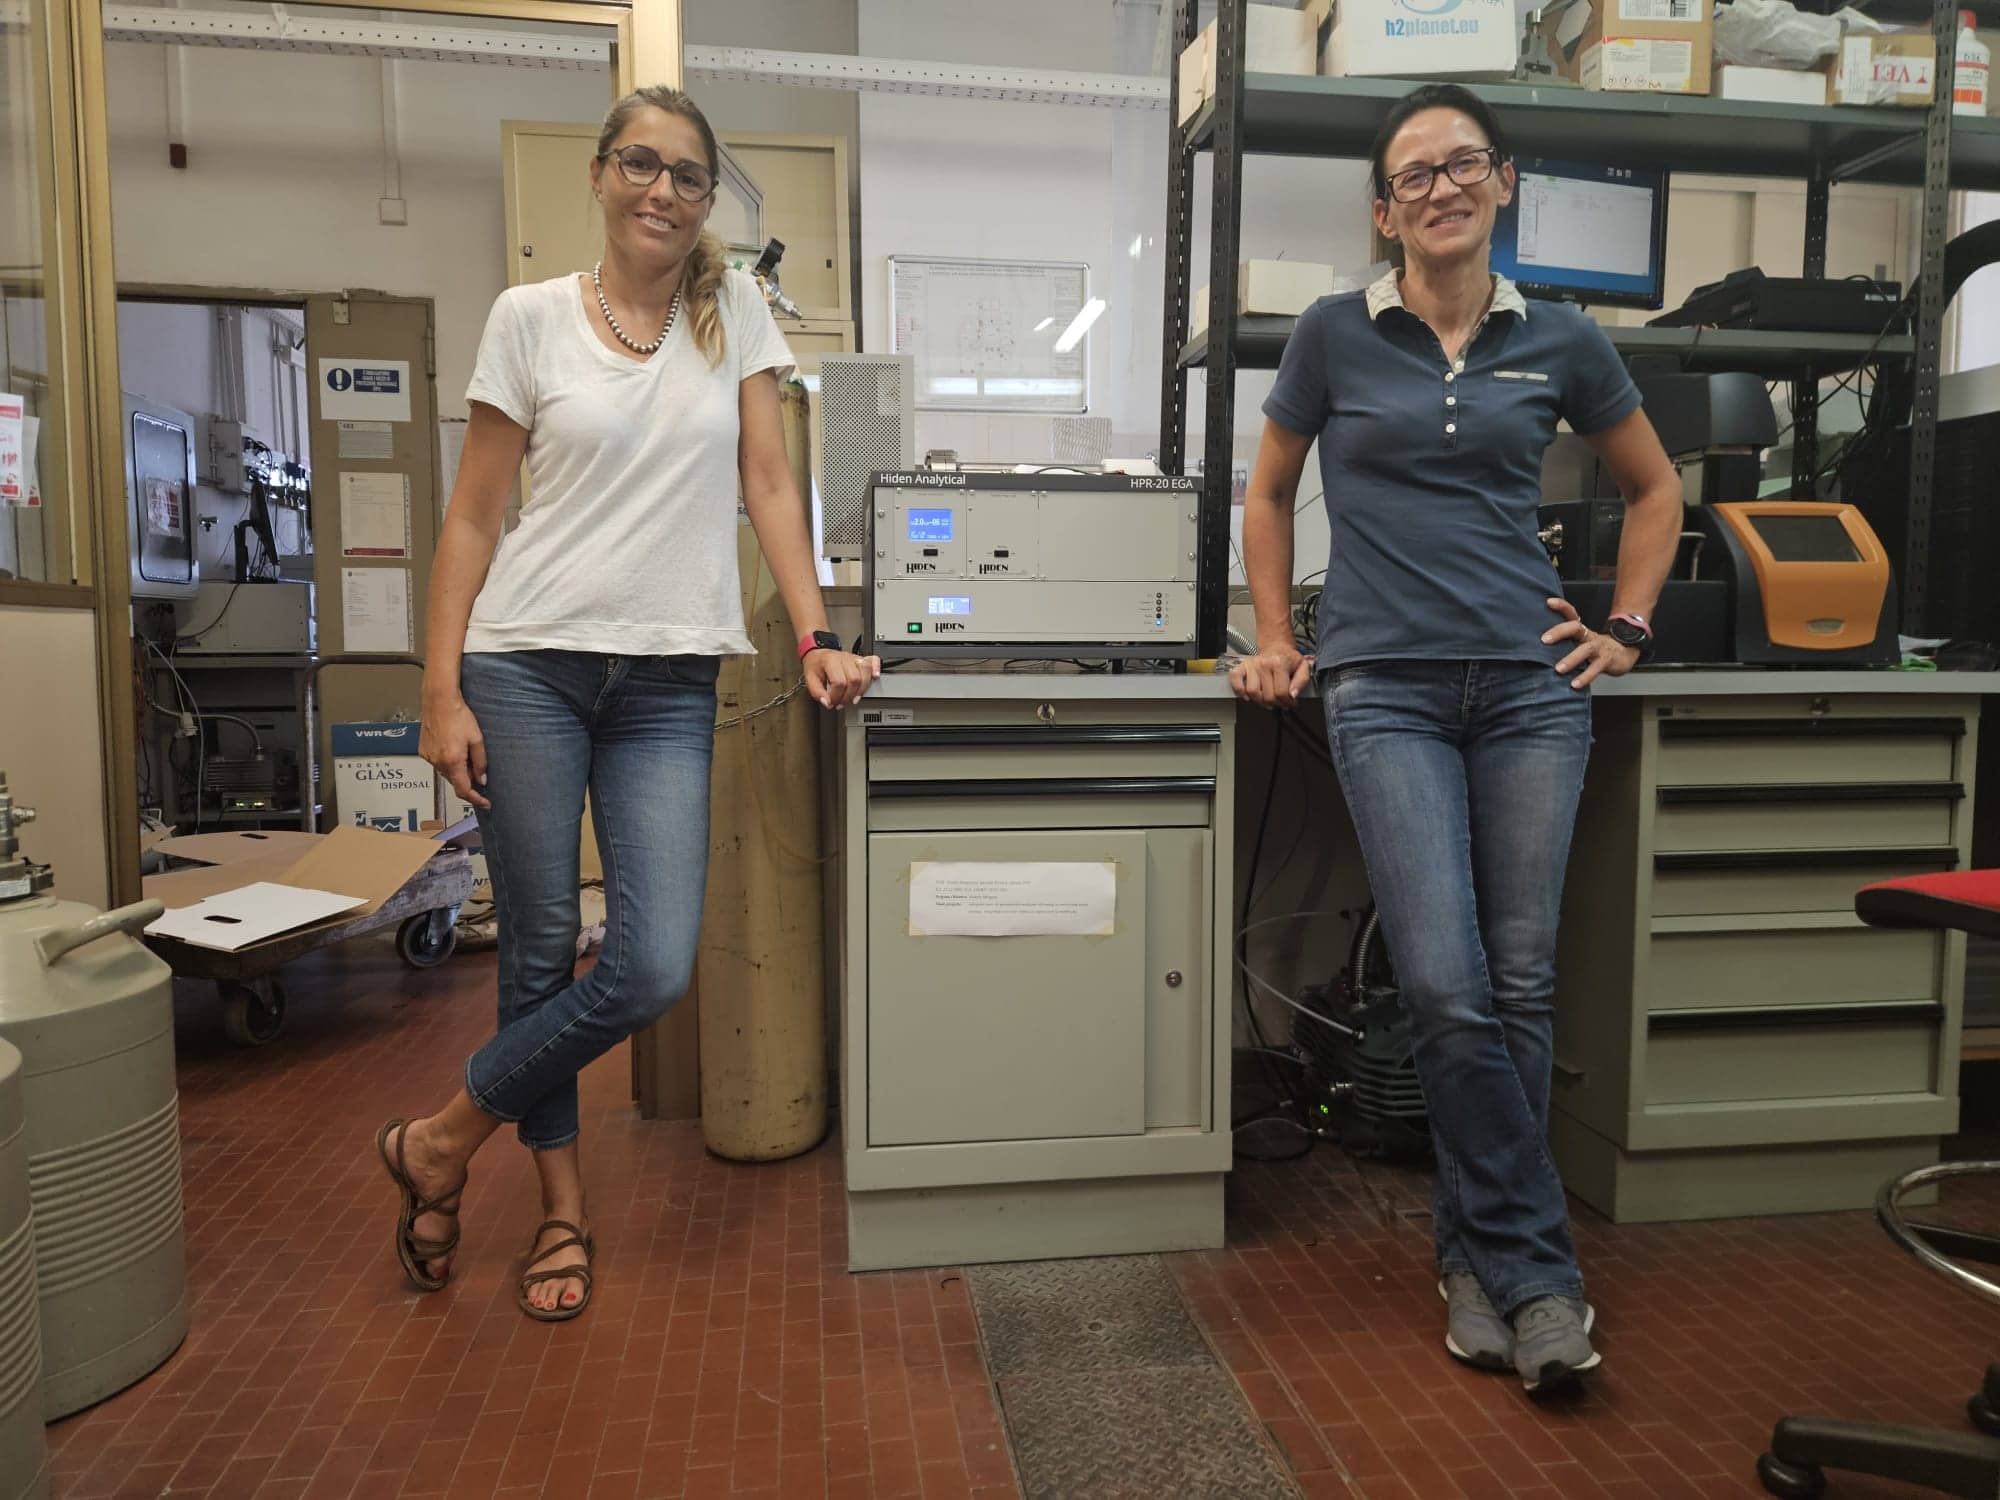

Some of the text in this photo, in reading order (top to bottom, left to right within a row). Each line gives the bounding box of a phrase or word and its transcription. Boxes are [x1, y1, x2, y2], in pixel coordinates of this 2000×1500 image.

[1385, 18, 1478, 38] h2planet.eu
[880, 473, 966, 487] Hiden Analytical
[1130, 478, 1194, 489] HPR-20 EGA
[935, 622, 965, 633] HIDEN
[355, 730, 382, 738] VWR
[355, 768, 403, 781] GLASS
[381, 780, 430, 790] DISPOSAL
